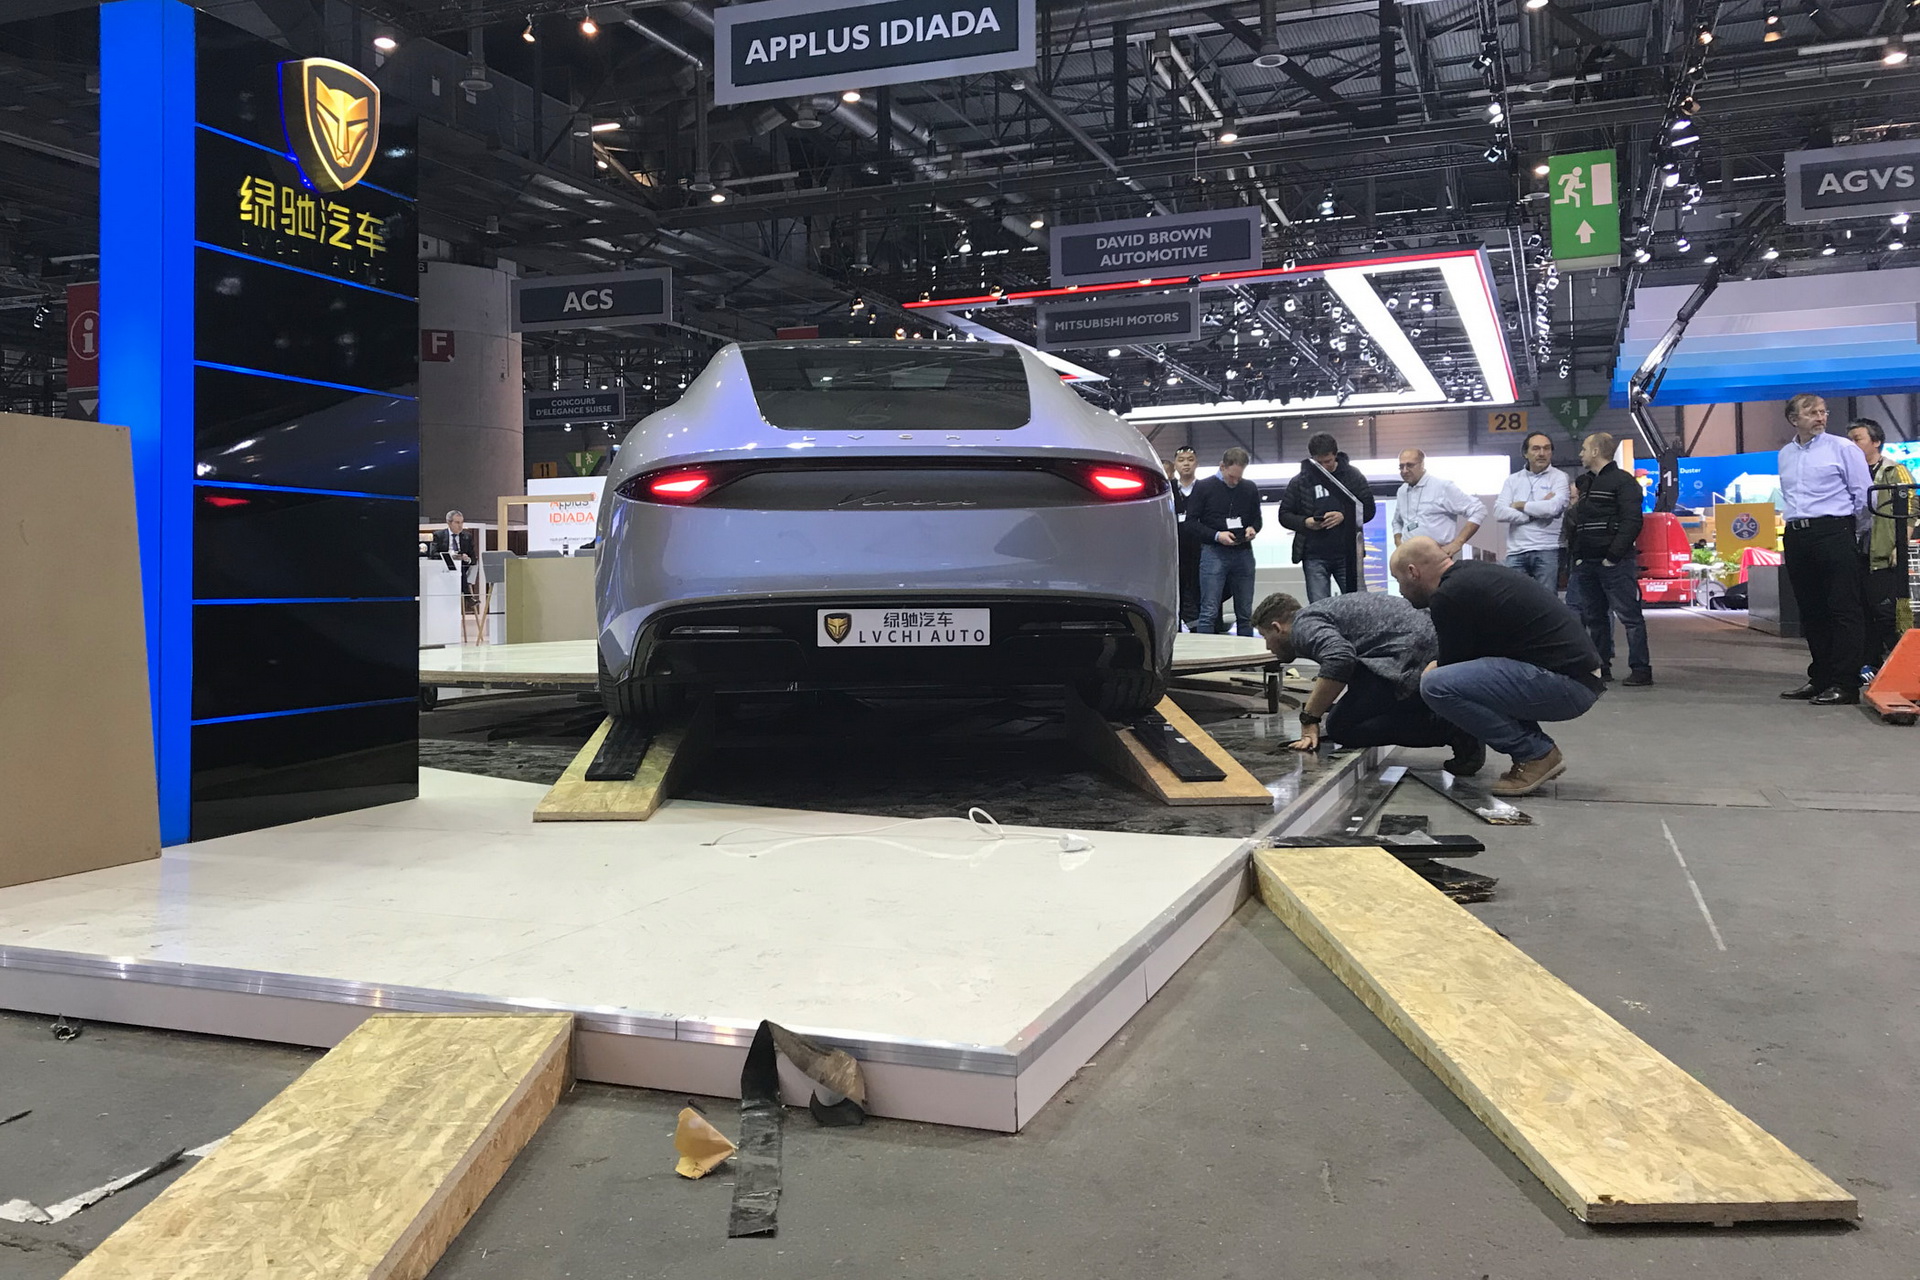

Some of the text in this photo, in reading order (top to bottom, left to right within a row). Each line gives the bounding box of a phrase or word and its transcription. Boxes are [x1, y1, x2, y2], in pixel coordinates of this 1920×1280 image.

[745, 7, 1000, 65] APPLUS IDIADA
[1817, 165, 1915, 196] AGVS
[240, 175, 387, 258] 绿驰汽车
[1096, 226, 1212, 250] DAVID BROWN
[1100, 245, 1208, 267] AUTOMOTIVE
[562, 288, 614, 313] ACS
[1054, 312, 1179, 331] MITSUBISHI MOTORS
[431, 332, 447, 354] F
[536, 405, 612, 417] D'ELEGANCE SUISSE
[551, 397, 596, 408] CONCOURS
[1494, 413, 1522, 431] 28
[541, 463, 549, 477] 11
[549, 512, 595, 523] IDIADA
[883, 611, 954, 628] 绿驰汽车
[859, 629, 985, 643] LVCHI AUTO
